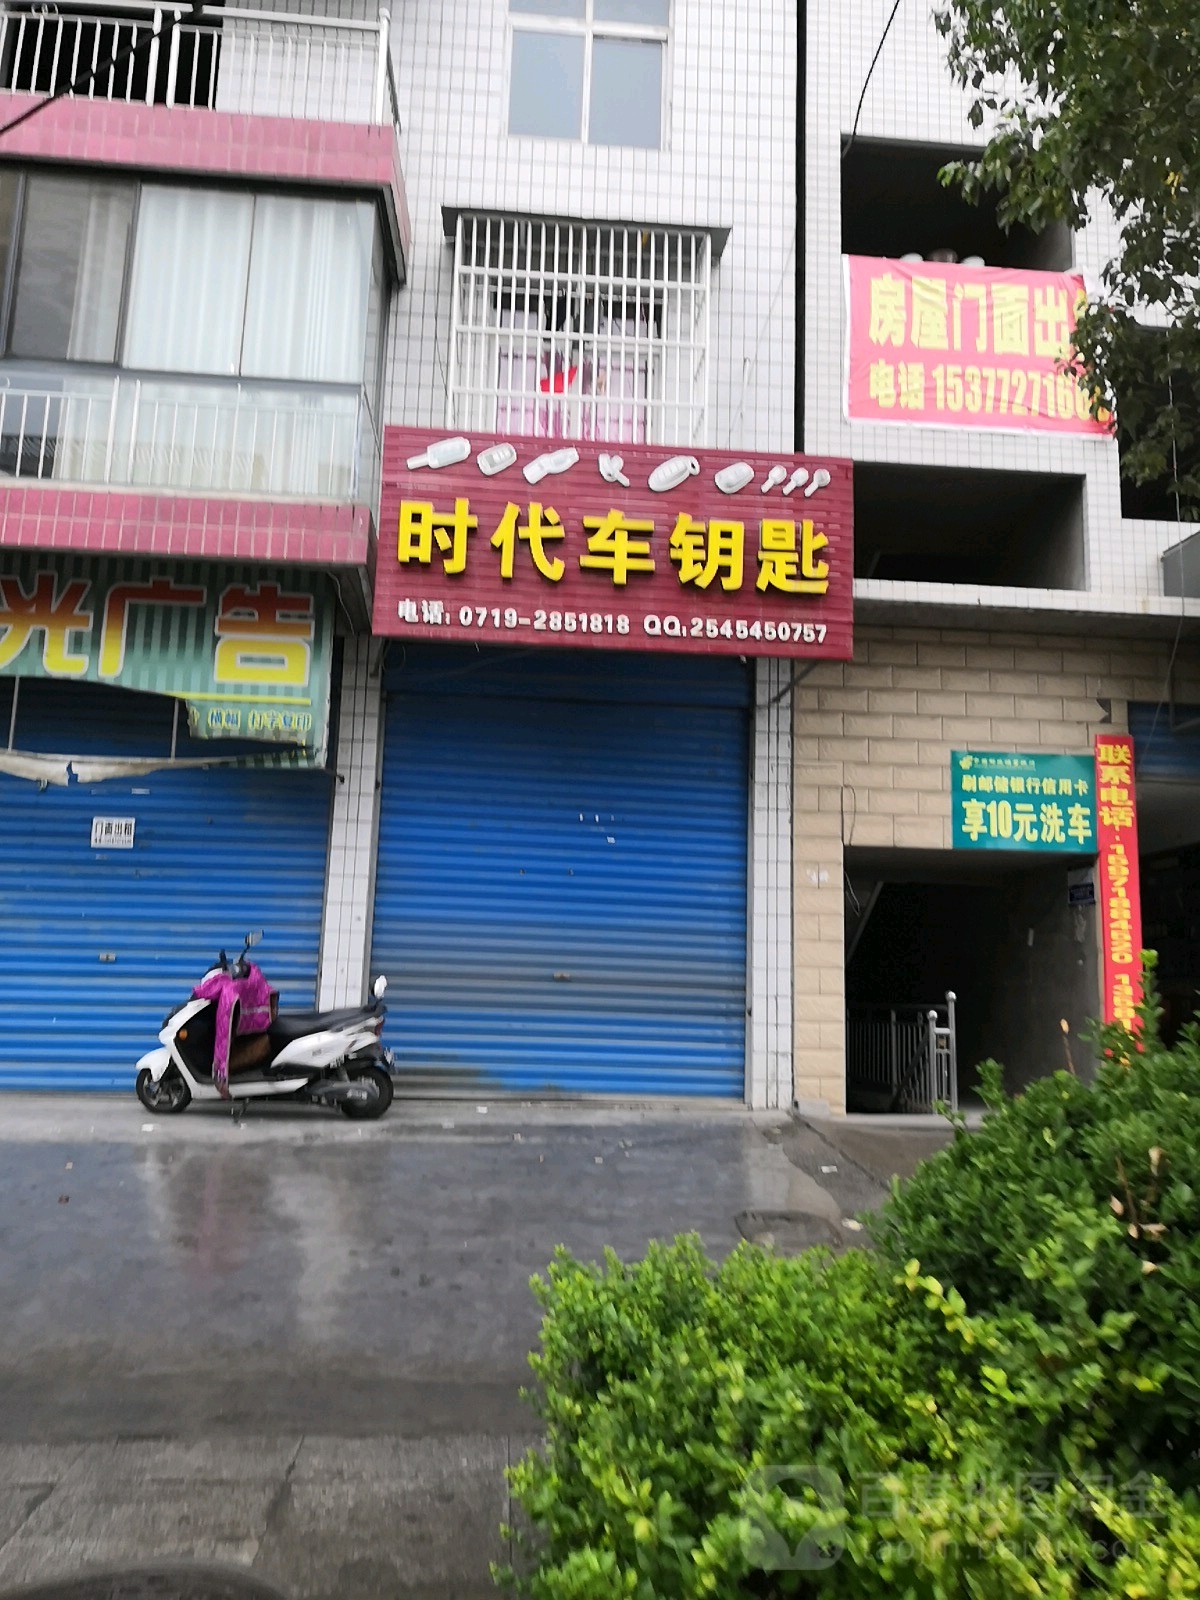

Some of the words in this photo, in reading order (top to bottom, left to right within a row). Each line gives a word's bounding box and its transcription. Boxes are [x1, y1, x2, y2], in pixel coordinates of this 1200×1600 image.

[868, 359, 925, 410] 电话
[398, 497, 830, 594] 时代车钥匙
[459, 605, 630, 635] 0719-2851818
[961, 798, 1093, 845] 享10元洗车
